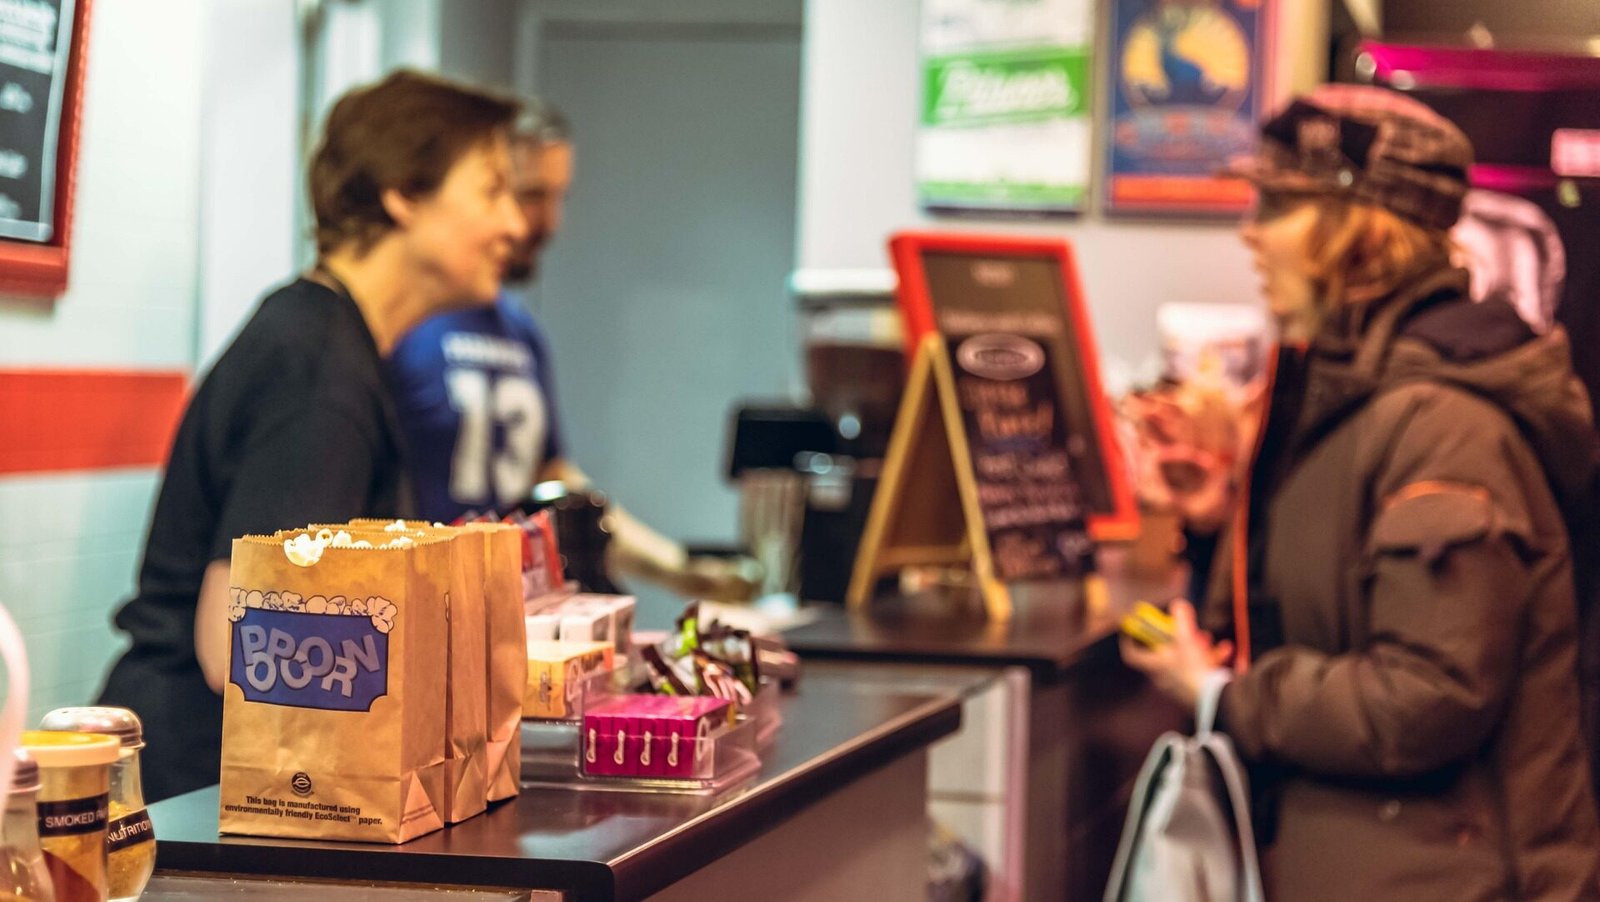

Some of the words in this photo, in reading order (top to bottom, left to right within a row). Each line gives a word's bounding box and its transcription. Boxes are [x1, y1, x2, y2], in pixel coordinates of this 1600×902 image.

[224, 804, 284, 817] environmentally
[285, 809, 313, 820] friendly
[358, 816, 383, 826] paper.
[246, 795, 262, 805] This
[263, 797, 277, 808] bag
[278, 799, 286, 807] is
[287, 800, 338, 813] manufactured
[339, 805, 361, 815] using
[45, 811, 95, 828] SMOKED
